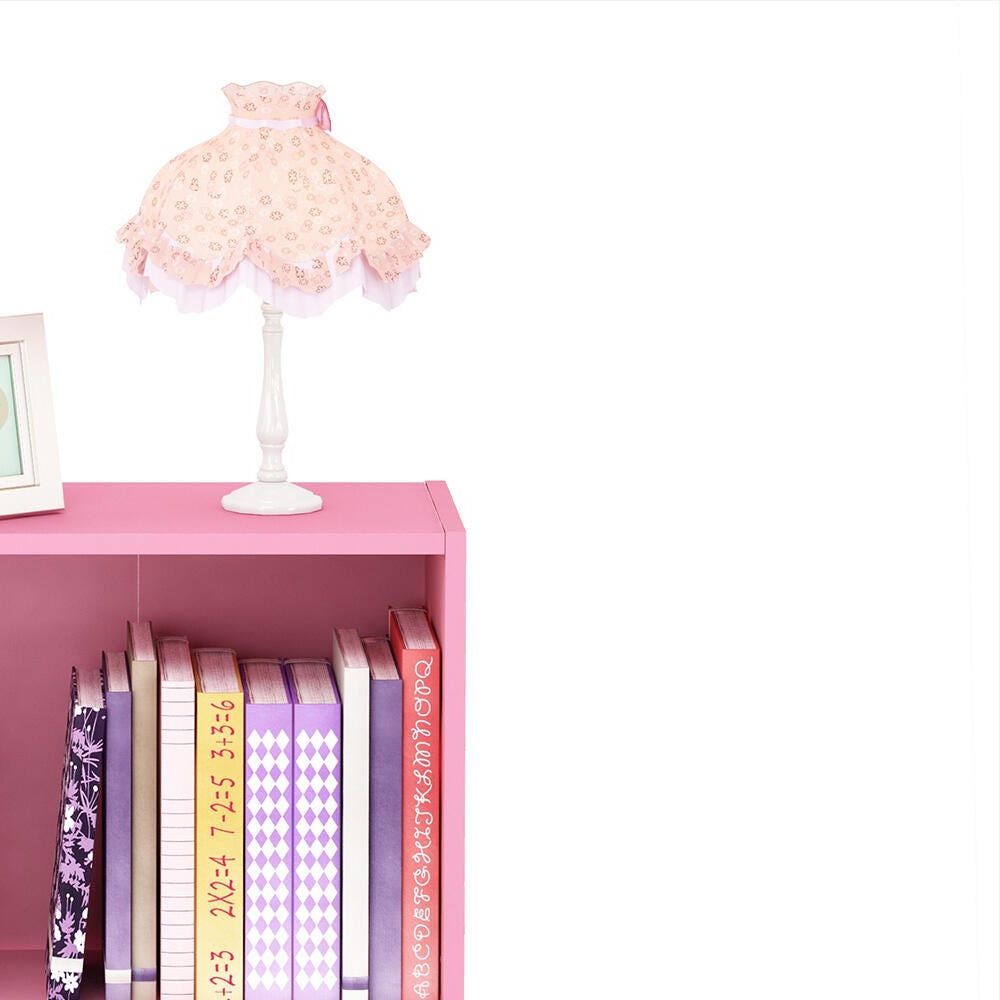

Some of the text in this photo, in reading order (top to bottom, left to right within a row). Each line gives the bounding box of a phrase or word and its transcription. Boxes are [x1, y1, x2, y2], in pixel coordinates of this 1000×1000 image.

[209, 699, 236, 760] 3+3=6
[210, 776, 236, 837] 7-2=5
[208, 854, 236, 918] 2X2=4
